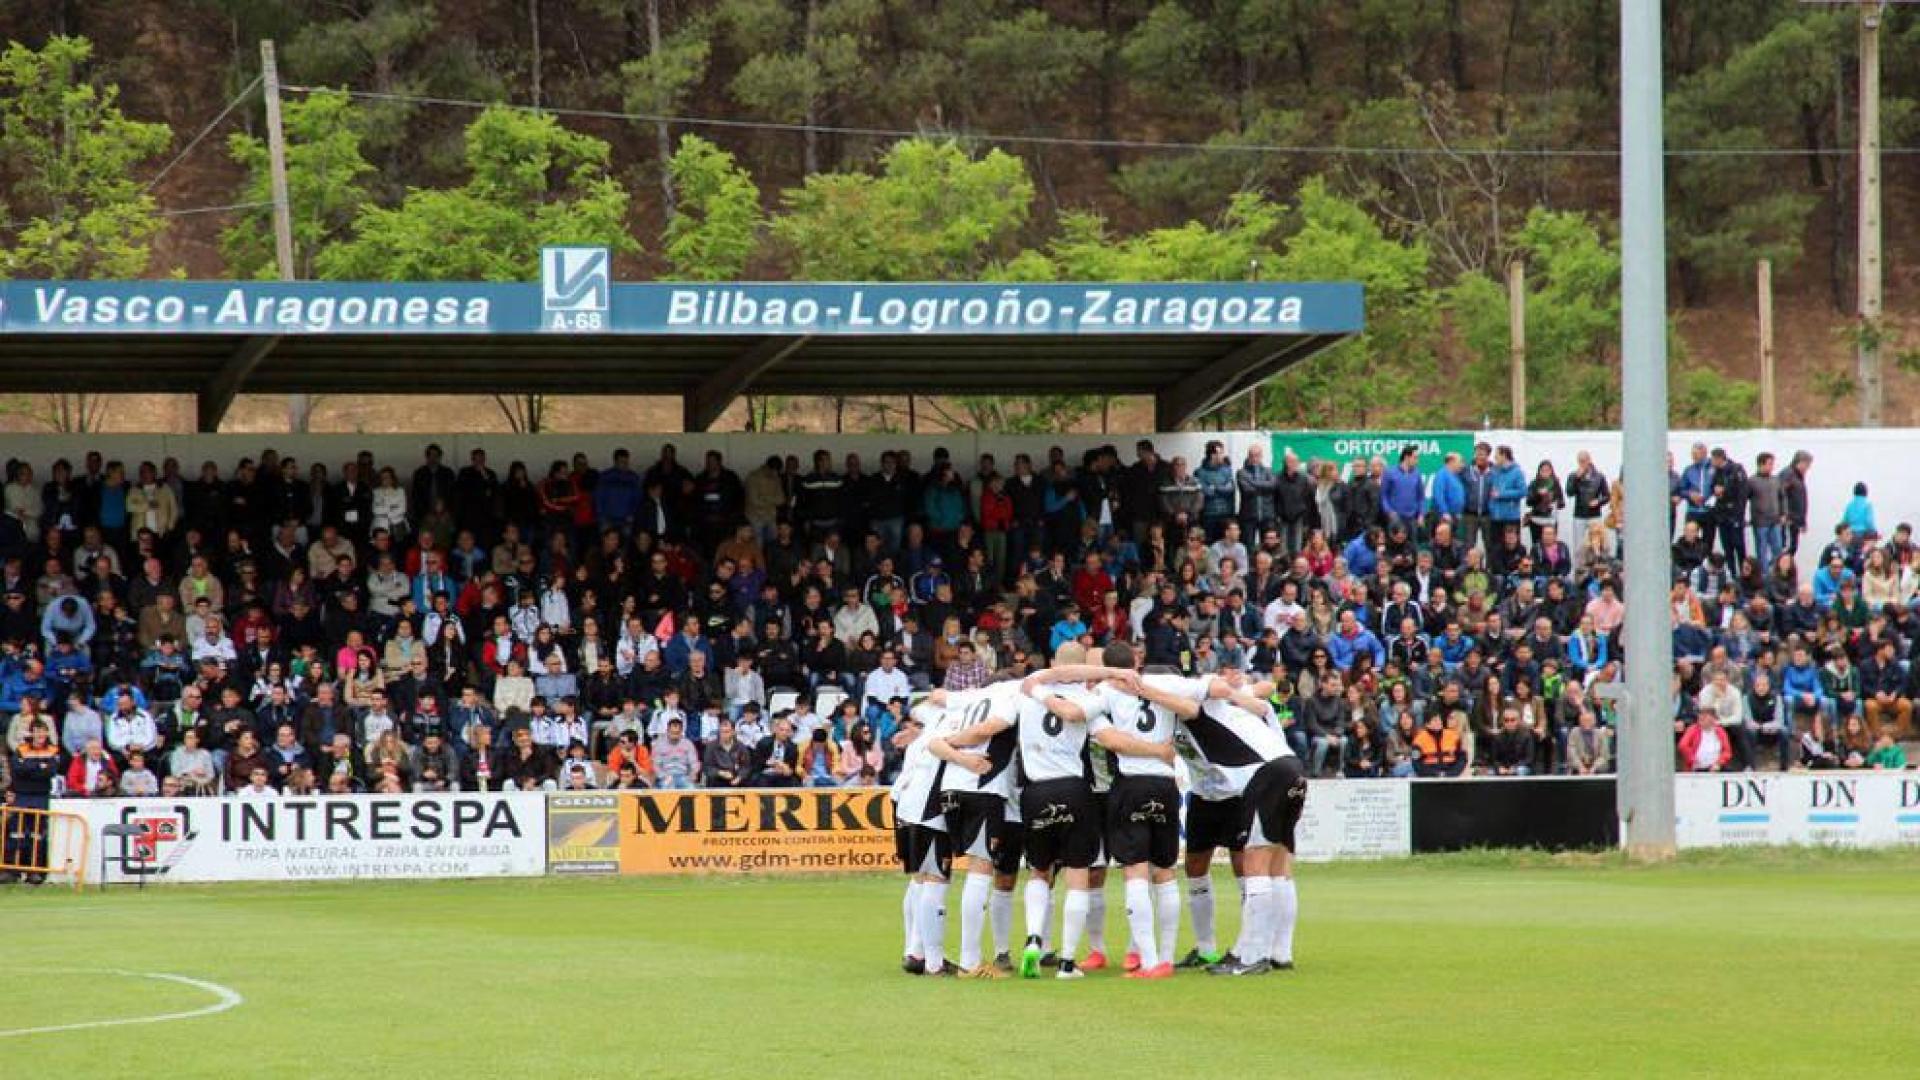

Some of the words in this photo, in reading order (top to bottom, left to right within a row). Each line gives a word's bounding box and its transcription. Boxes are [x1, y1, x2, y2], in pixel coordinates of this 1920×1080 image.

[35, 288, 489, 331] Vasco-Aragonesa
[667, 288, 1303, 332] Bilbao-Logroño-Zaragoza
[1136, 695, 1156, 733] 3
[1721, 779, 1767, 808] DN
[1811, 779, 1857, 808] DN
[220, 799, 522, 841] INTRESPA
[235, 848, 280, 860] TRIPA
[285, 846, 357, 859] NATURAL
[376, 845, 421, 857] TRIPA
[425, 844, 512, 857] ENTUBADA
